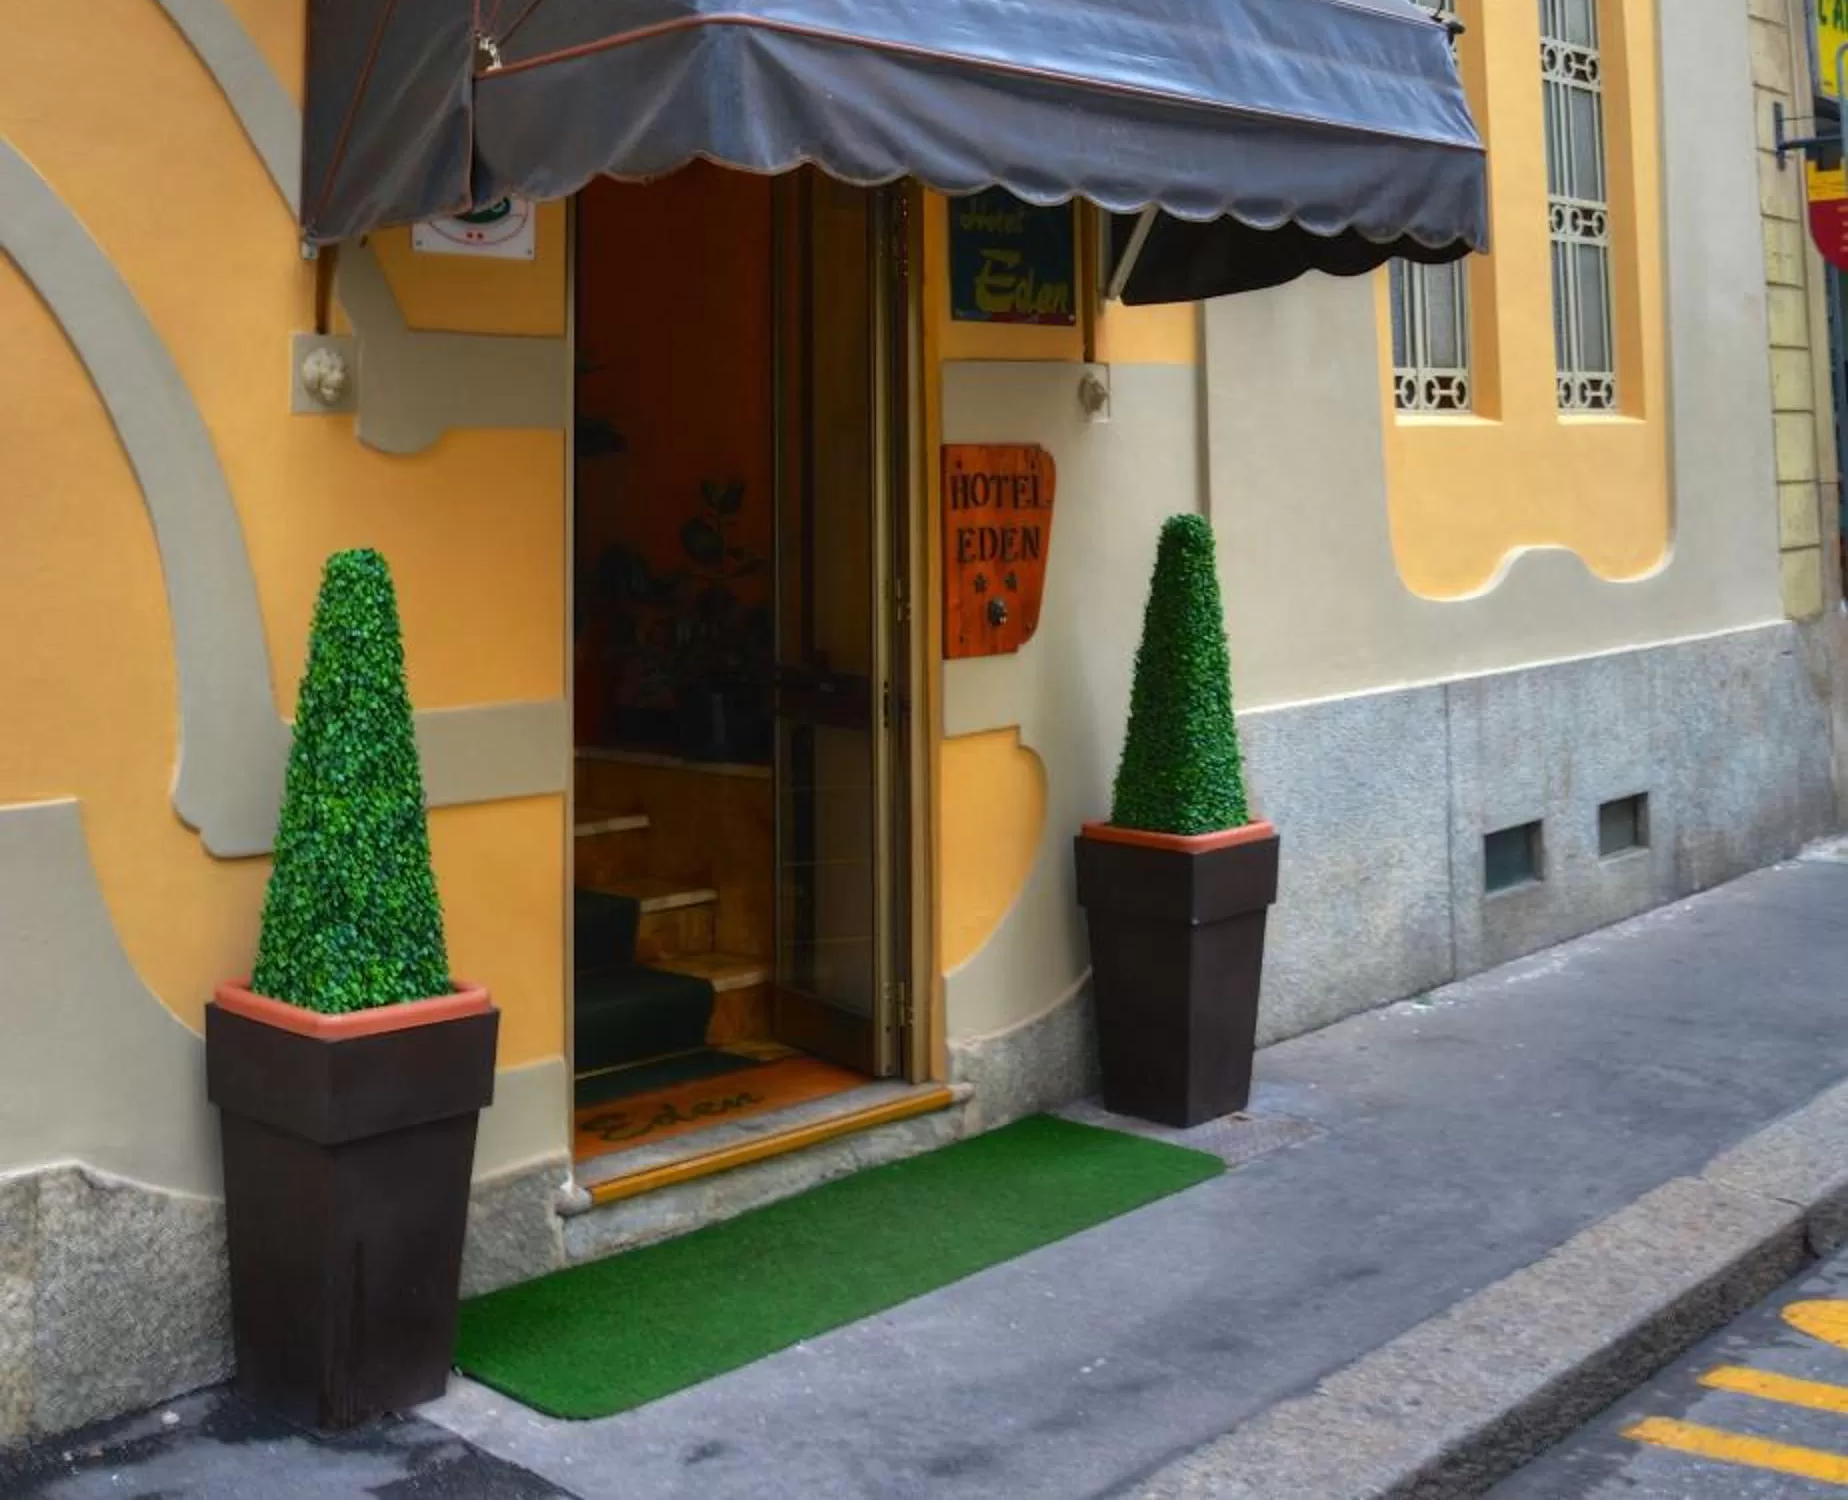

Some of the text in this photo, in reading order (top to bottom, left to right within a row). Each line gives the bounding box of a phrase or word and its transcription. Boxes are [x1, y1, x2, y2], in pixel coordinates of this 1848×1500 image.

[972, 248, 1069, 313] Eden
[951, 472, 1051, 510] HOTEL
[957, 525, 1040, 564] EDEN
